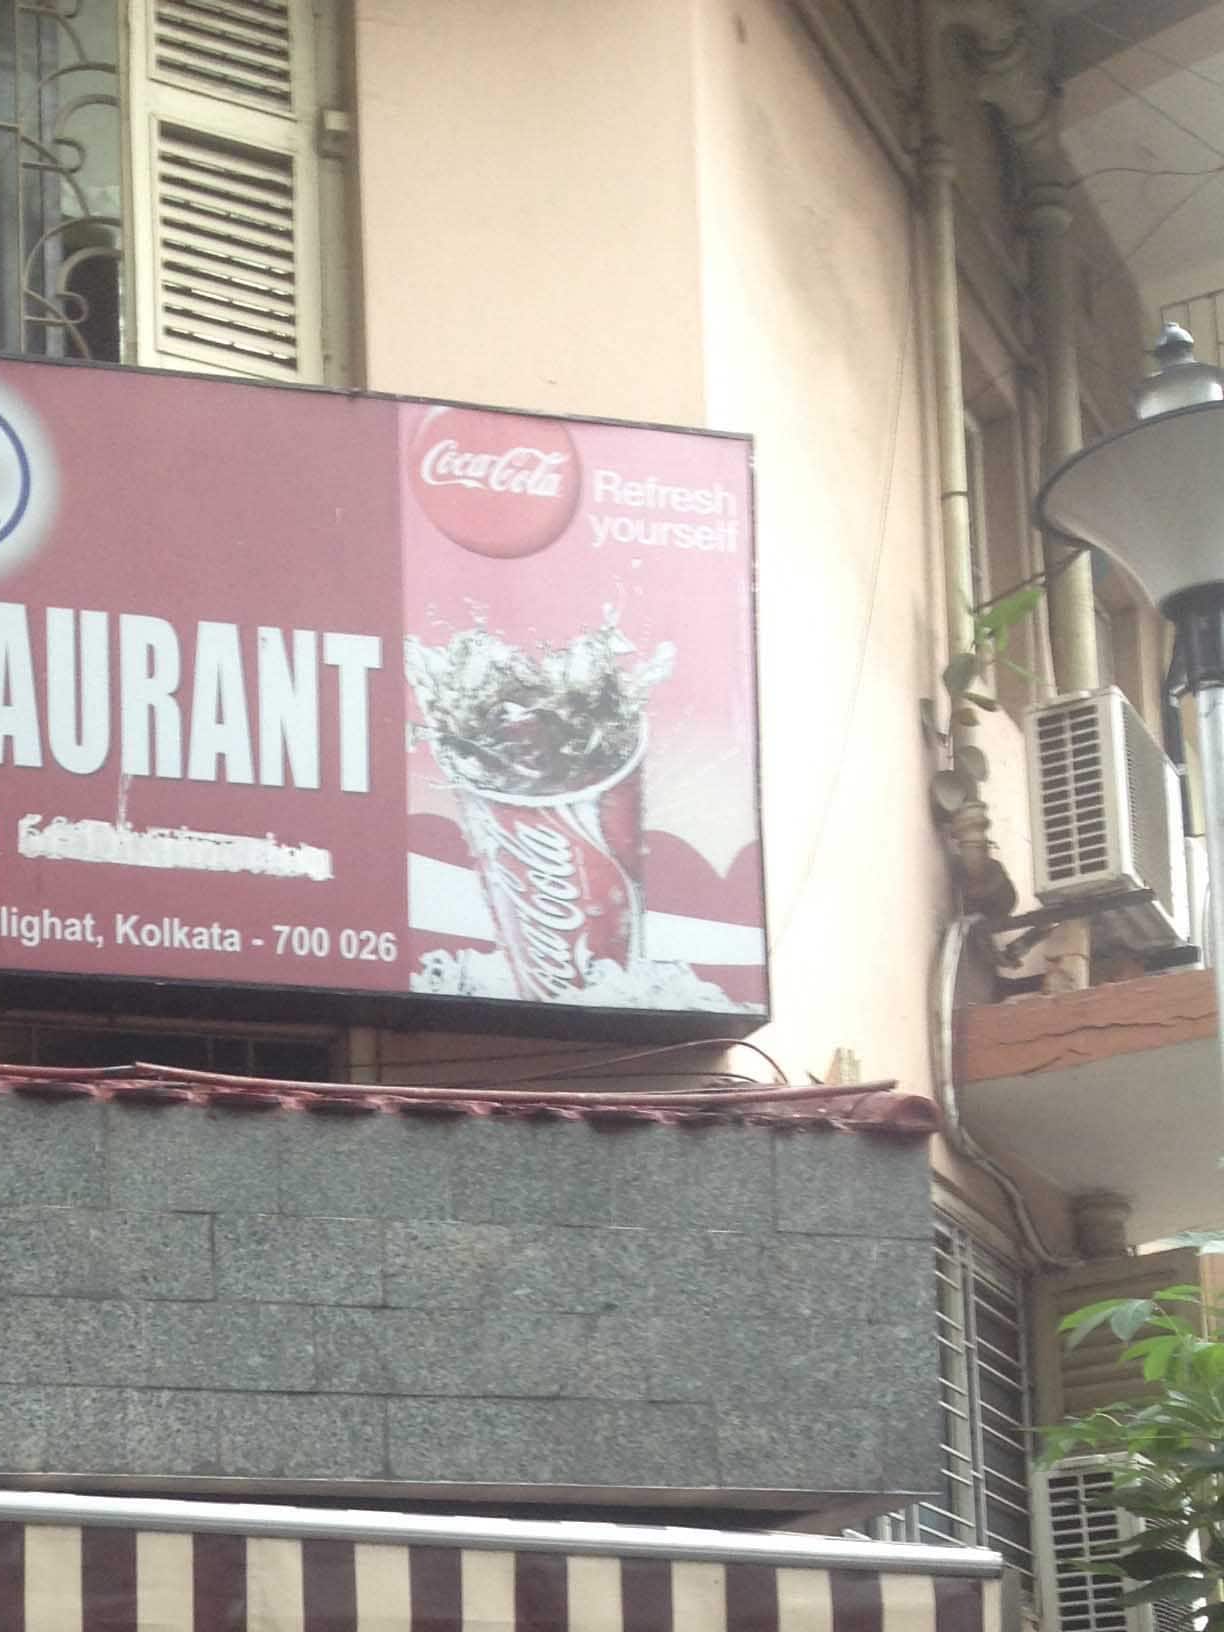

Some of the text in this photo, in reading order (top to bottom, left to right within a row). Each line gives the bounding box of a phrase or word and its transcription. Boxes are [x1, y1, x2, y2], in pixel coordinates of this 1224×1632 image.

[420, 439, 569, 497] Coca-Cola
[592, 468, 737, 517] Refresh
[588, 512, 739, 552] yourself
[115, 913, 241, 952] Kolkata
[273, 925, 331, 957] 700
[340, 930, 398, 962] 026
